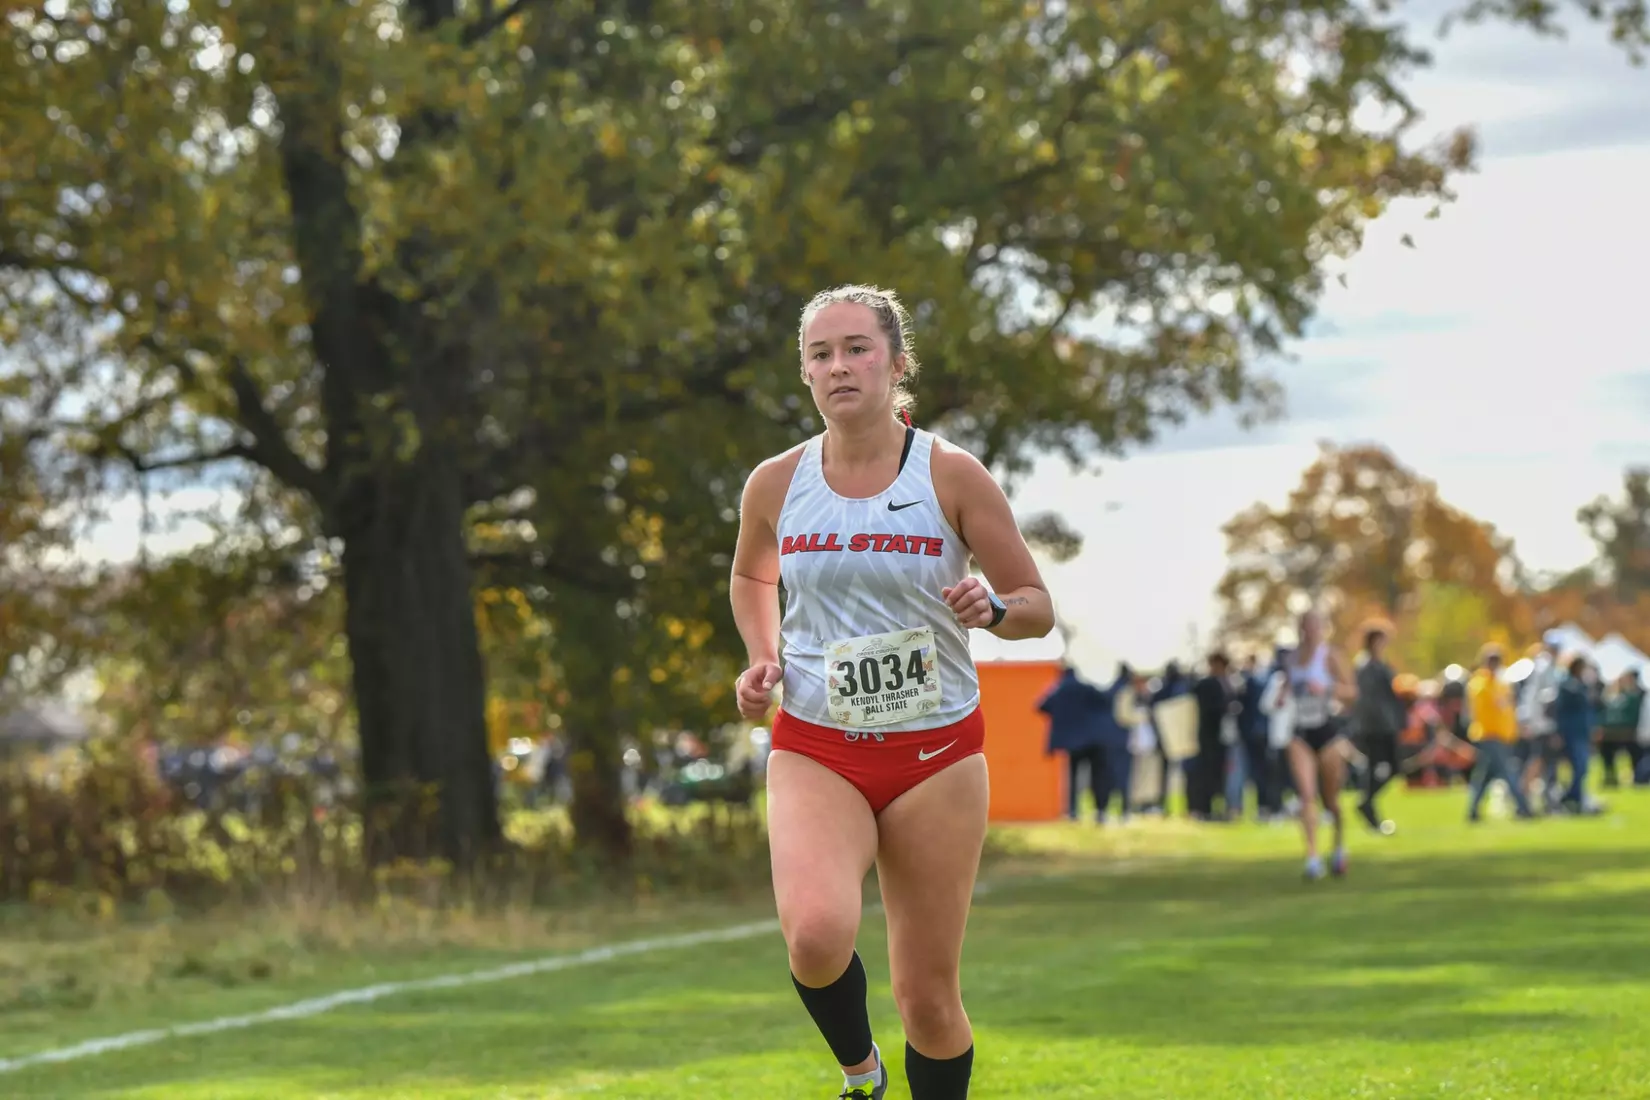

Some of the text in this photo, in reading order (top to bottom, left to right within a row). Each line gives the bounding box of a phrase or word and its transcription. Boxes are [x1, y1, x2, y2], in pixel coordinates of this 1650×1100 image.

[781, 533, 944, 557] BALL STATE
[837, 649, 927, 697] 3034
[851, 695, 880, 707] KENDYL
[881, 688, 919, 701] THRASHER
[865, 704, 884, 714] BALL
[886, 701, 908, 711] STATE
